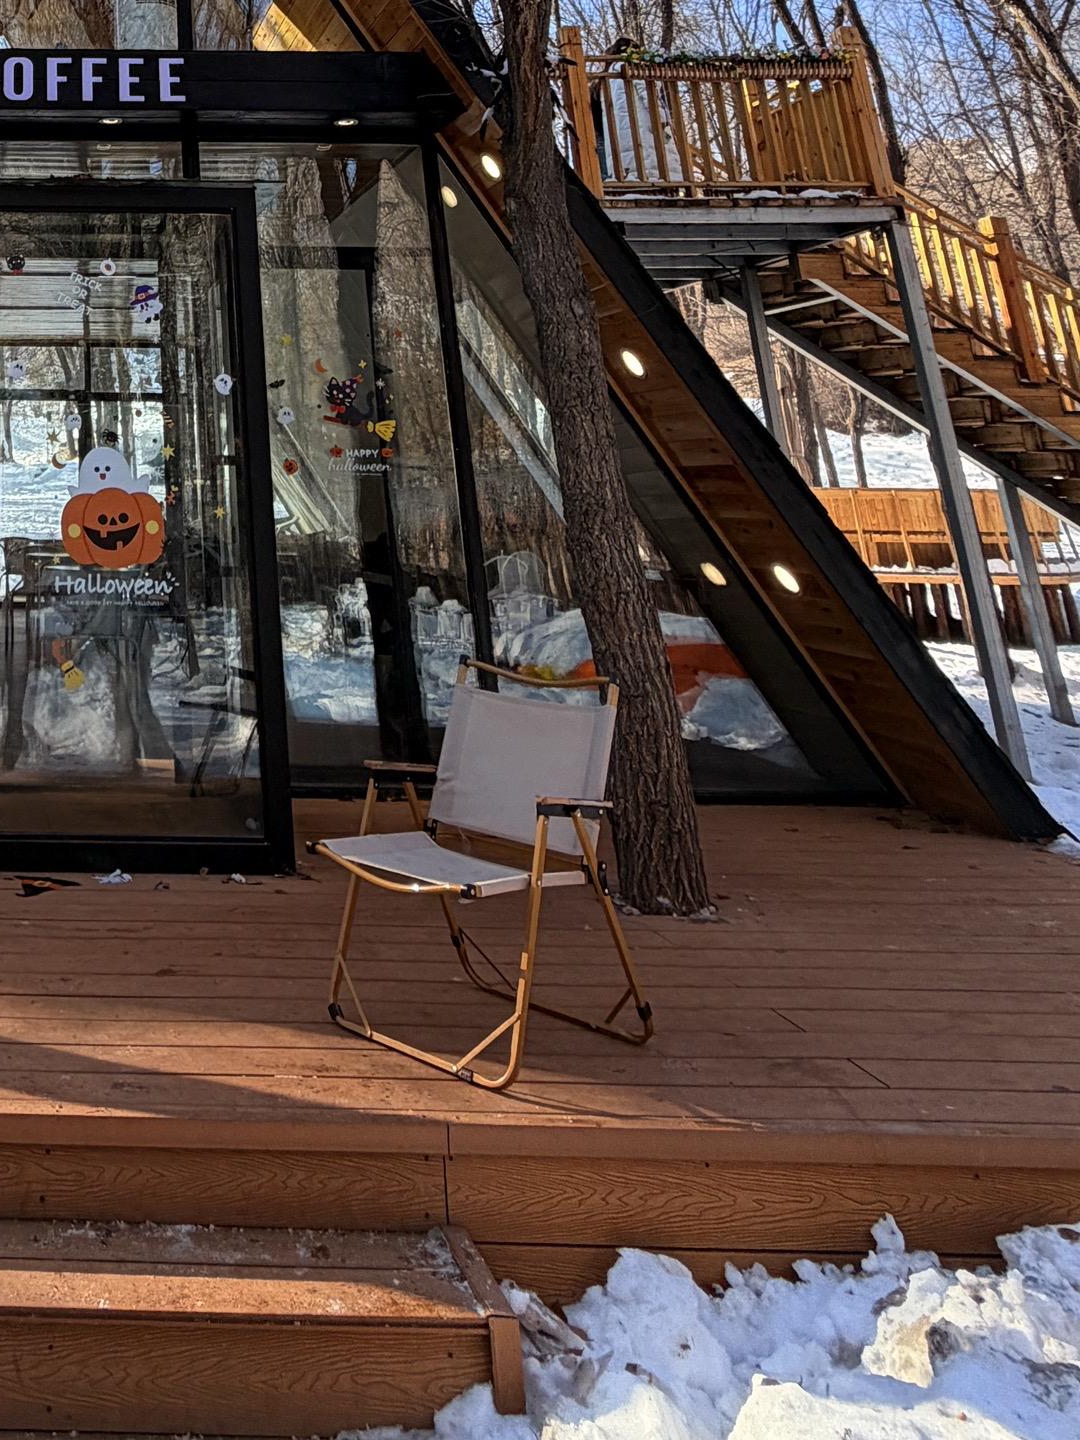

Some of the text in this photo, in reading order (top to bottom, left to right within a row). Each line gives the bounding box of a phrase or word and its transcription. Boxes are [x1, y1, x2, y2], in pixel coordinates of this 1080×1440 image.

[70, 271, 102, 292] TRICK
[72, 286, 88, 300] OR
[57, 292, 94, 318] TREAT
[345, 448, 379, 458] HAPPY
[328, 457, 392, 472] halloween
[54, 573, 173, 596] Halloween
